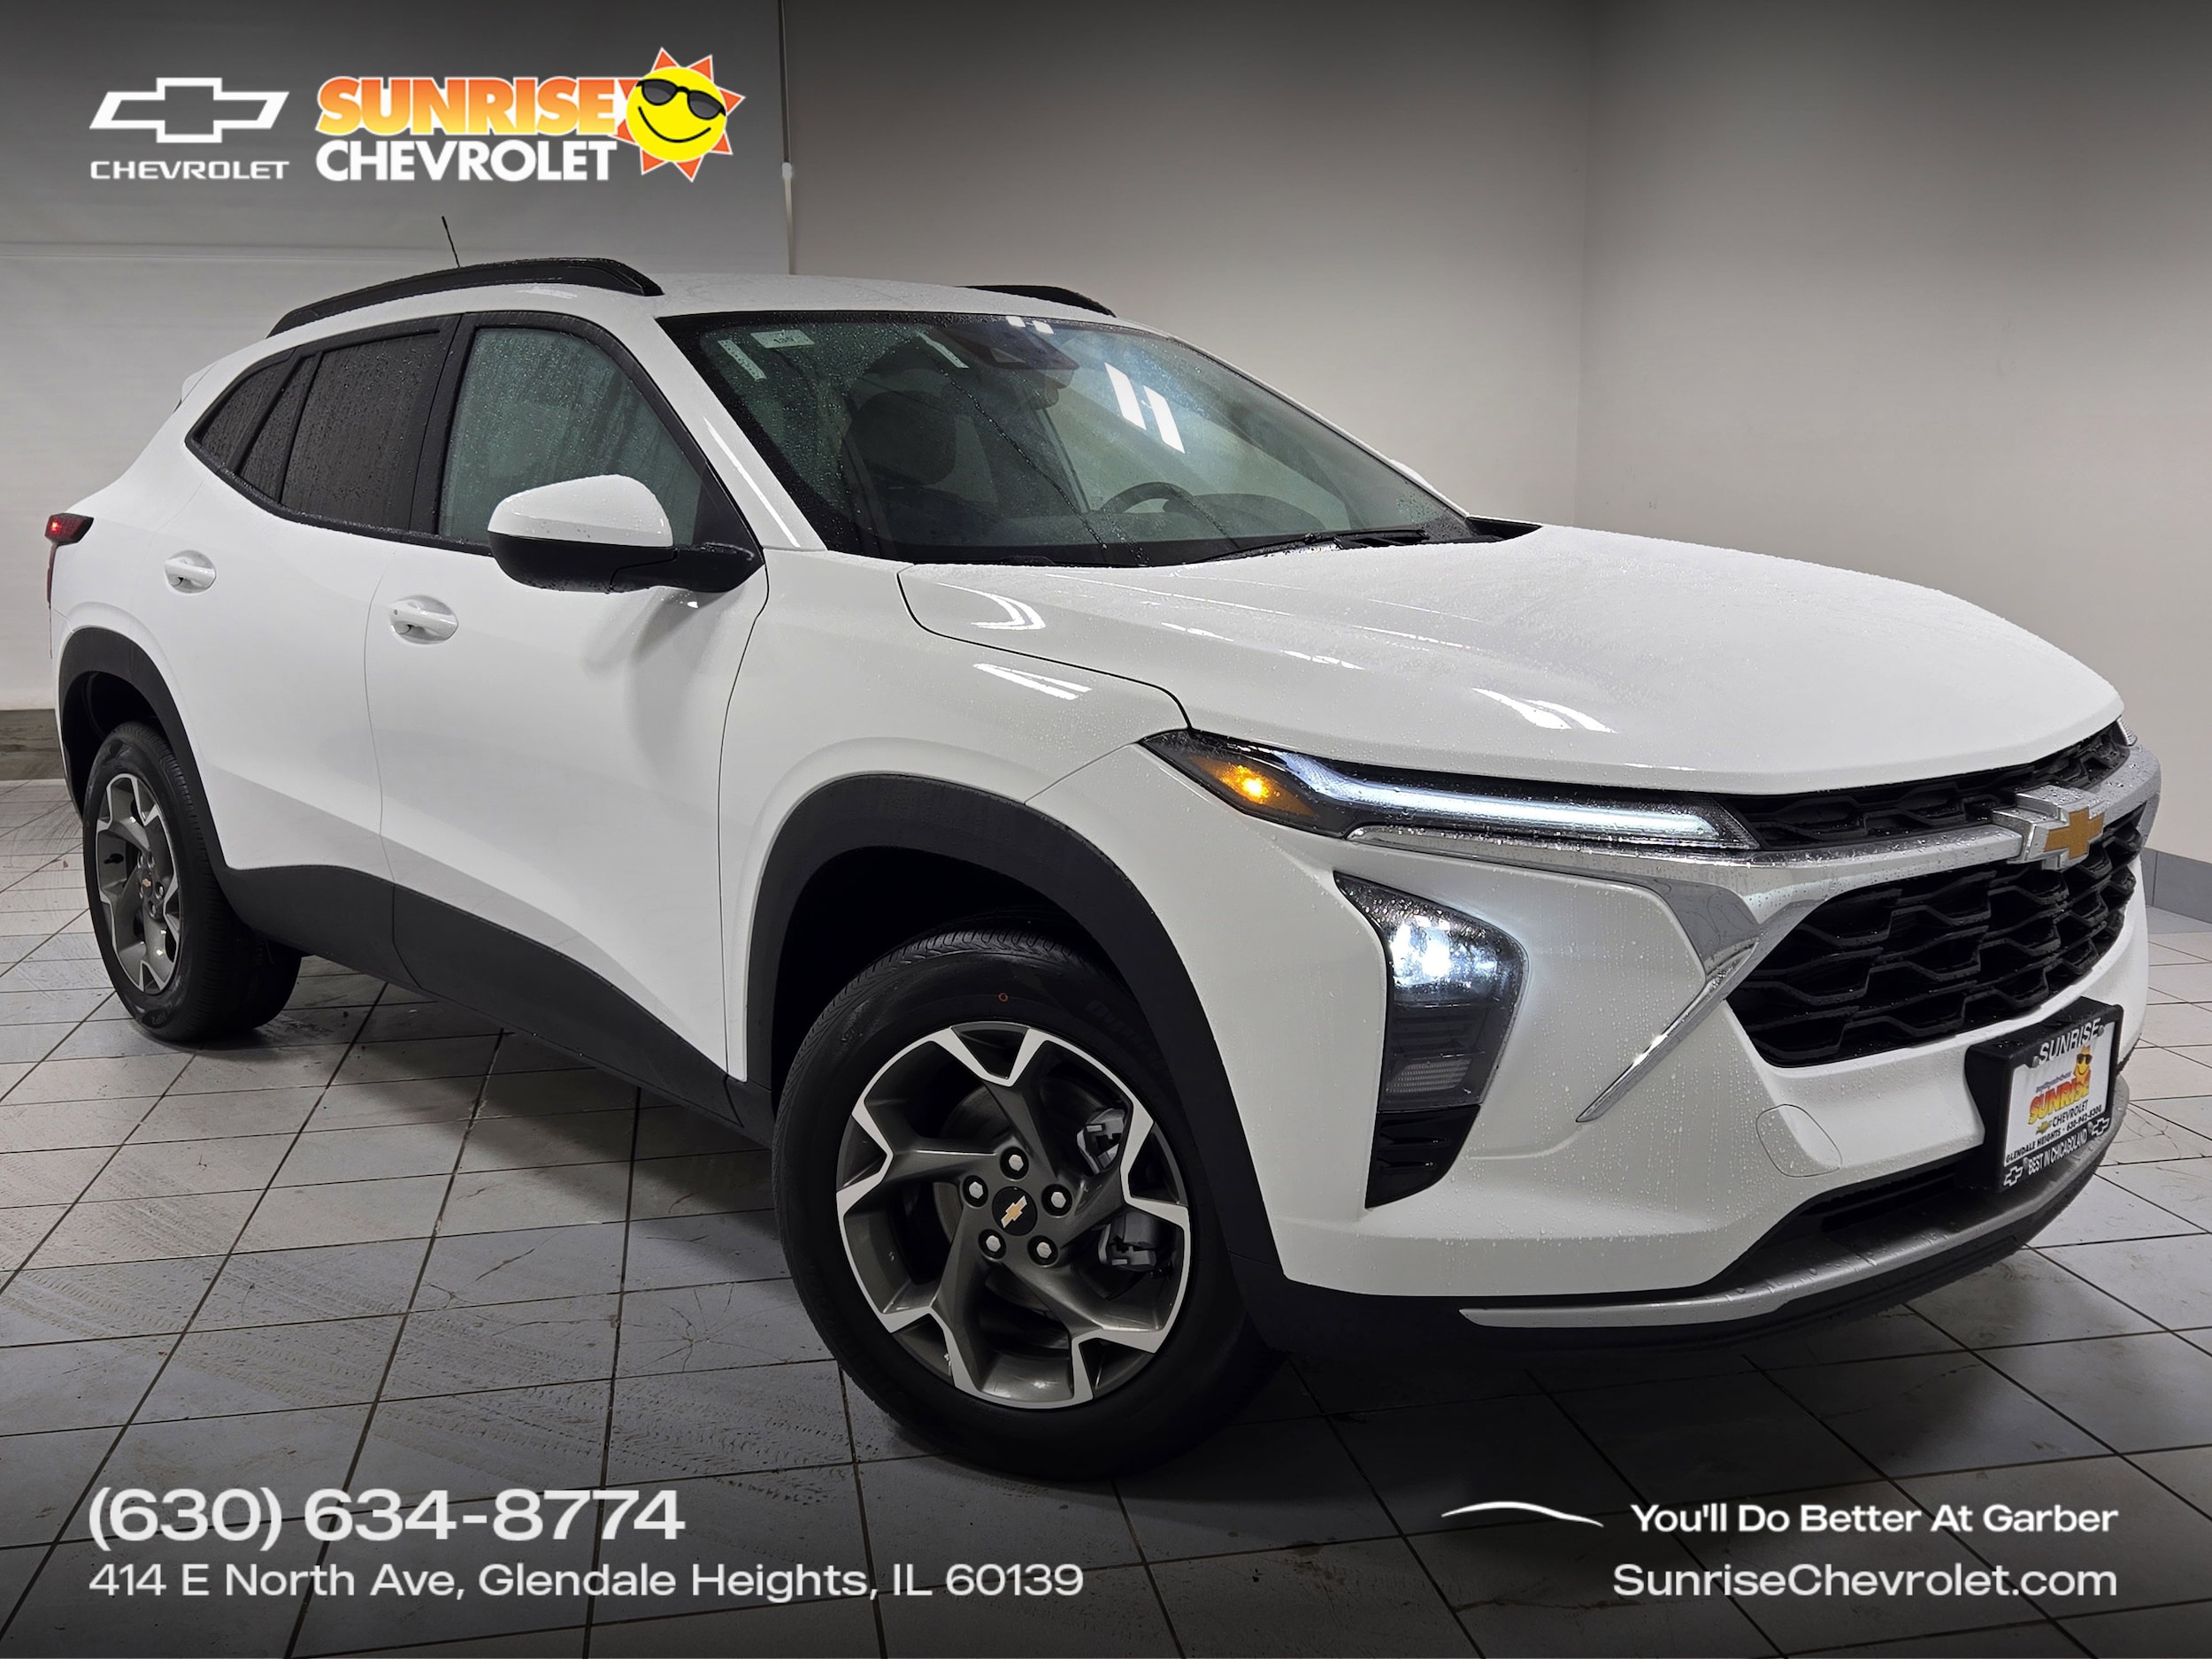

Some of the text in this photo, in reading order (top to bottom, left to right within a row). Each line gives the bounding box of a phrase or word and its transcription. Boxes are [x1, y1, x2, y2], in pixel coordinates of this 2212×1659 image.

[2039, 1018, 2101, 1063] SUNRISE
[2027, 1077, 2090, 1125] SUNRISE
[2052, 1099, 2089, 1127] CHEVROLET
[2006, 1141, 2036, 1164] GLENDALE
[2037, 1127, 2061, 1148] HEIGHTS
[2028, 1153, 2044, 1176] BEST
